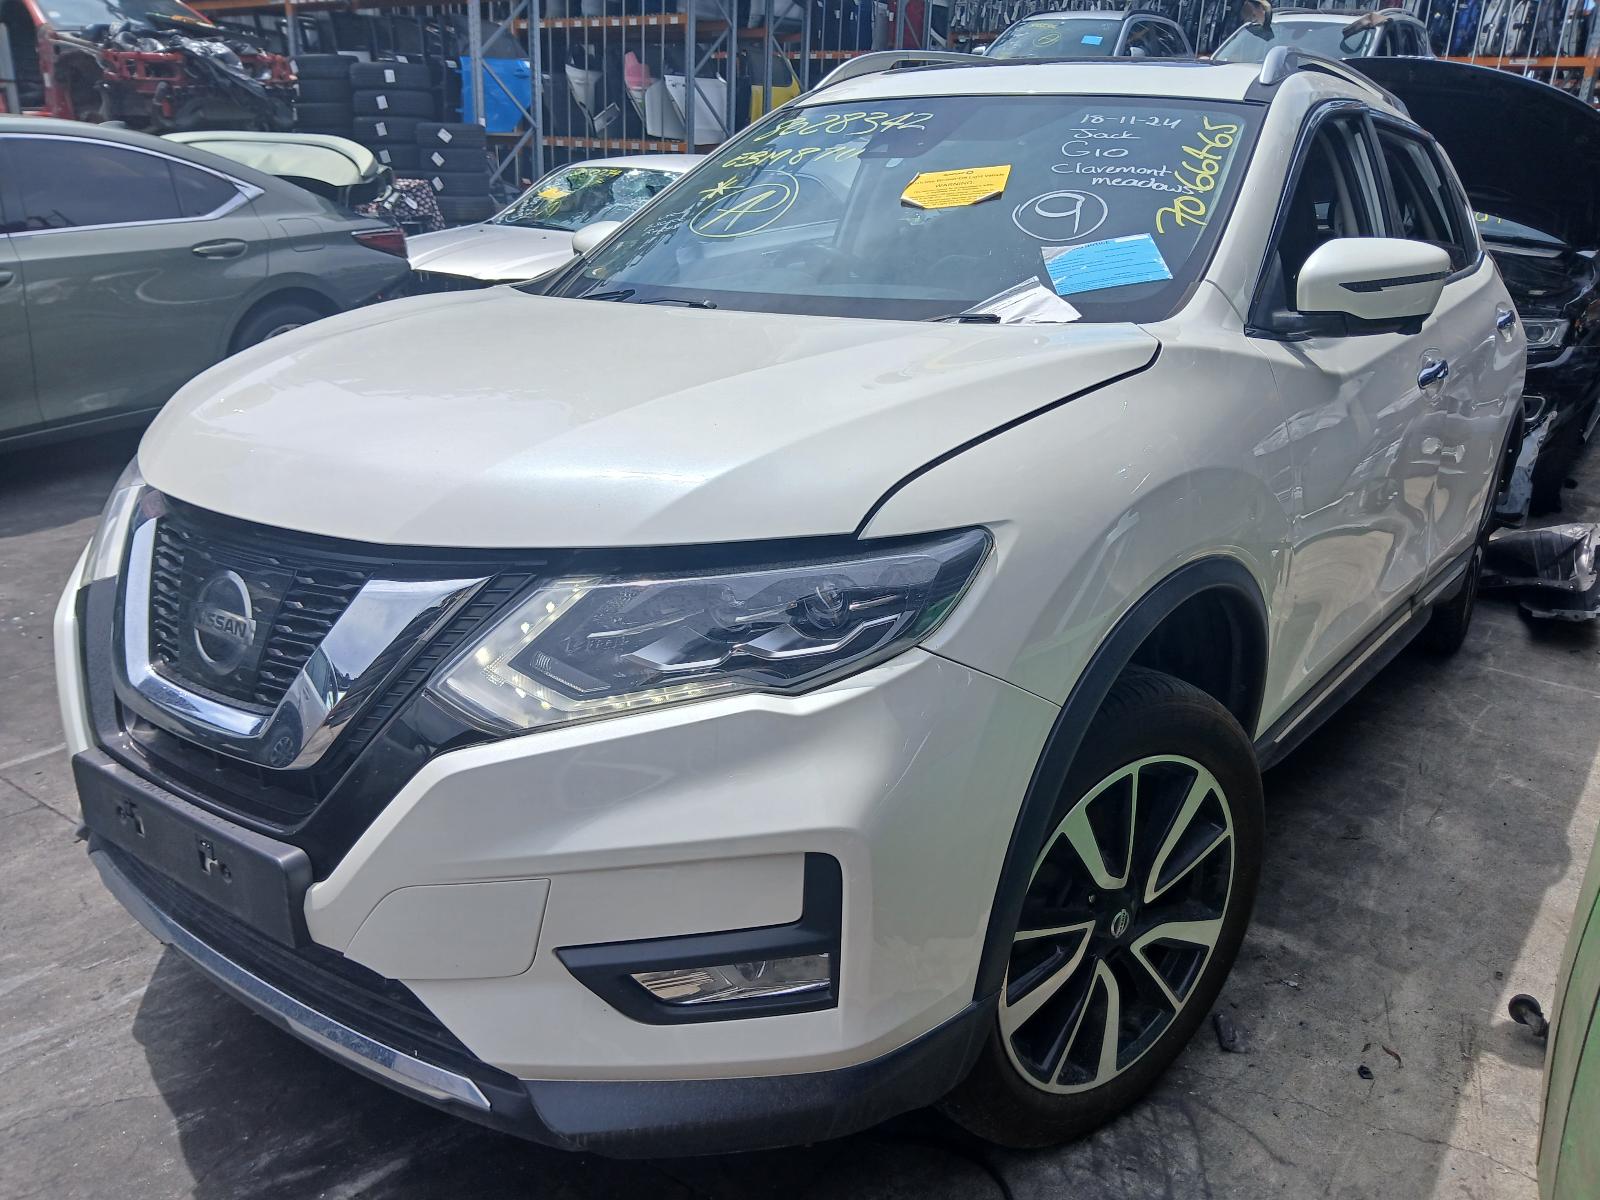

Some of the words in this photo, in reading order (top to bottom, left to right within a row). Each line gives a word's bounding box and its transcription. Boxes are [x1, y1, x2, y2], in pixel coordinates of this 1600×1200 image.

[1080, 114, 1182, 129] 18-11-24
[1069, 128, 1141, 139] Jack
[1051, 162, 1172, 177] Claremont
[1034, 193, 1086, 235] 9
[195, 606, 248, 638] NISSAN
